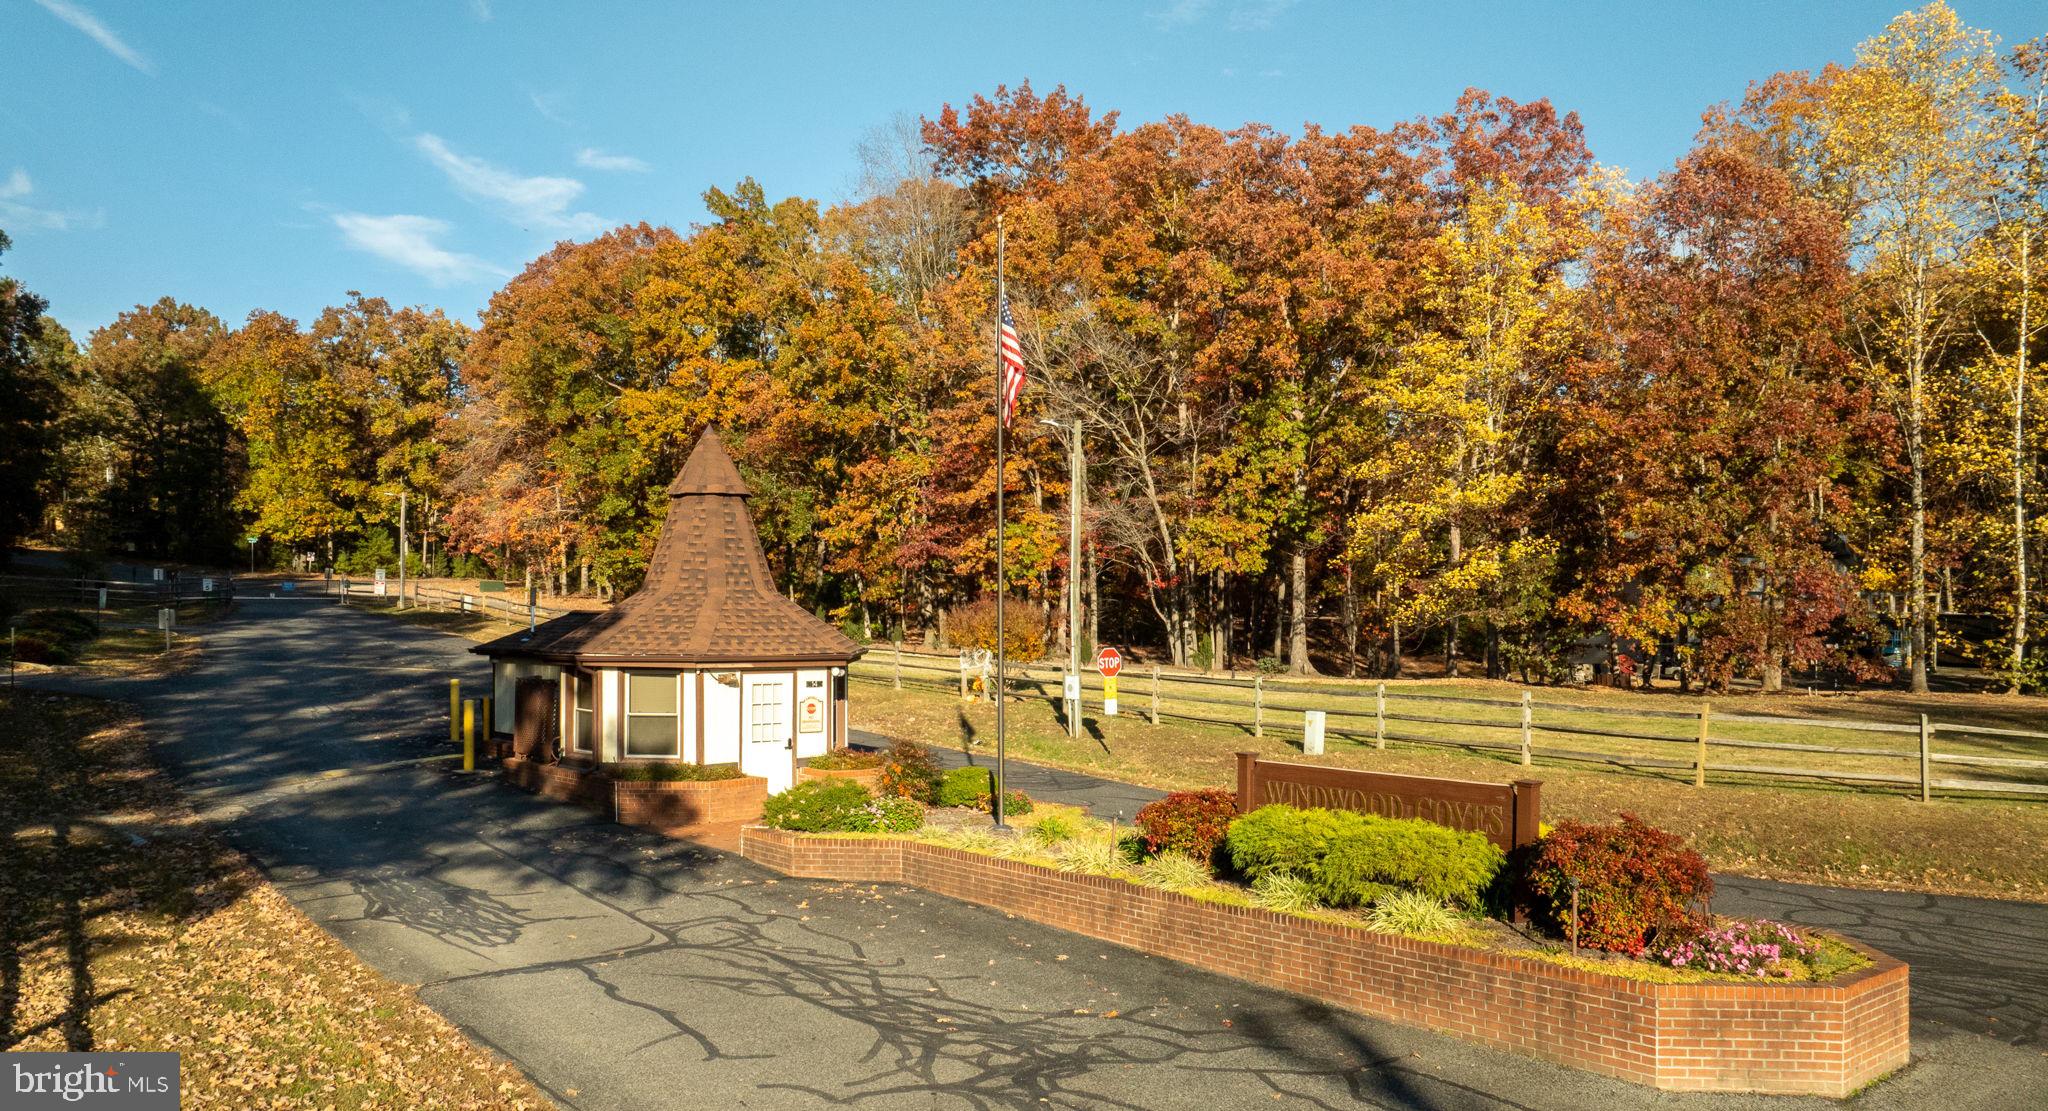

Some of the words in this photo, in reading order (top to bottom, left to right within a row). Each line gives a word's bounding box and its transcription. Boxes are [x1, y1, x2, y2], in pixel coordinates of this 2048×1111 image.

[1099, 657, 1120, 669] STOP
[1265, 780, 1403, 818] WINDWOOD
[1416, 797, 1503, 835] COVES
